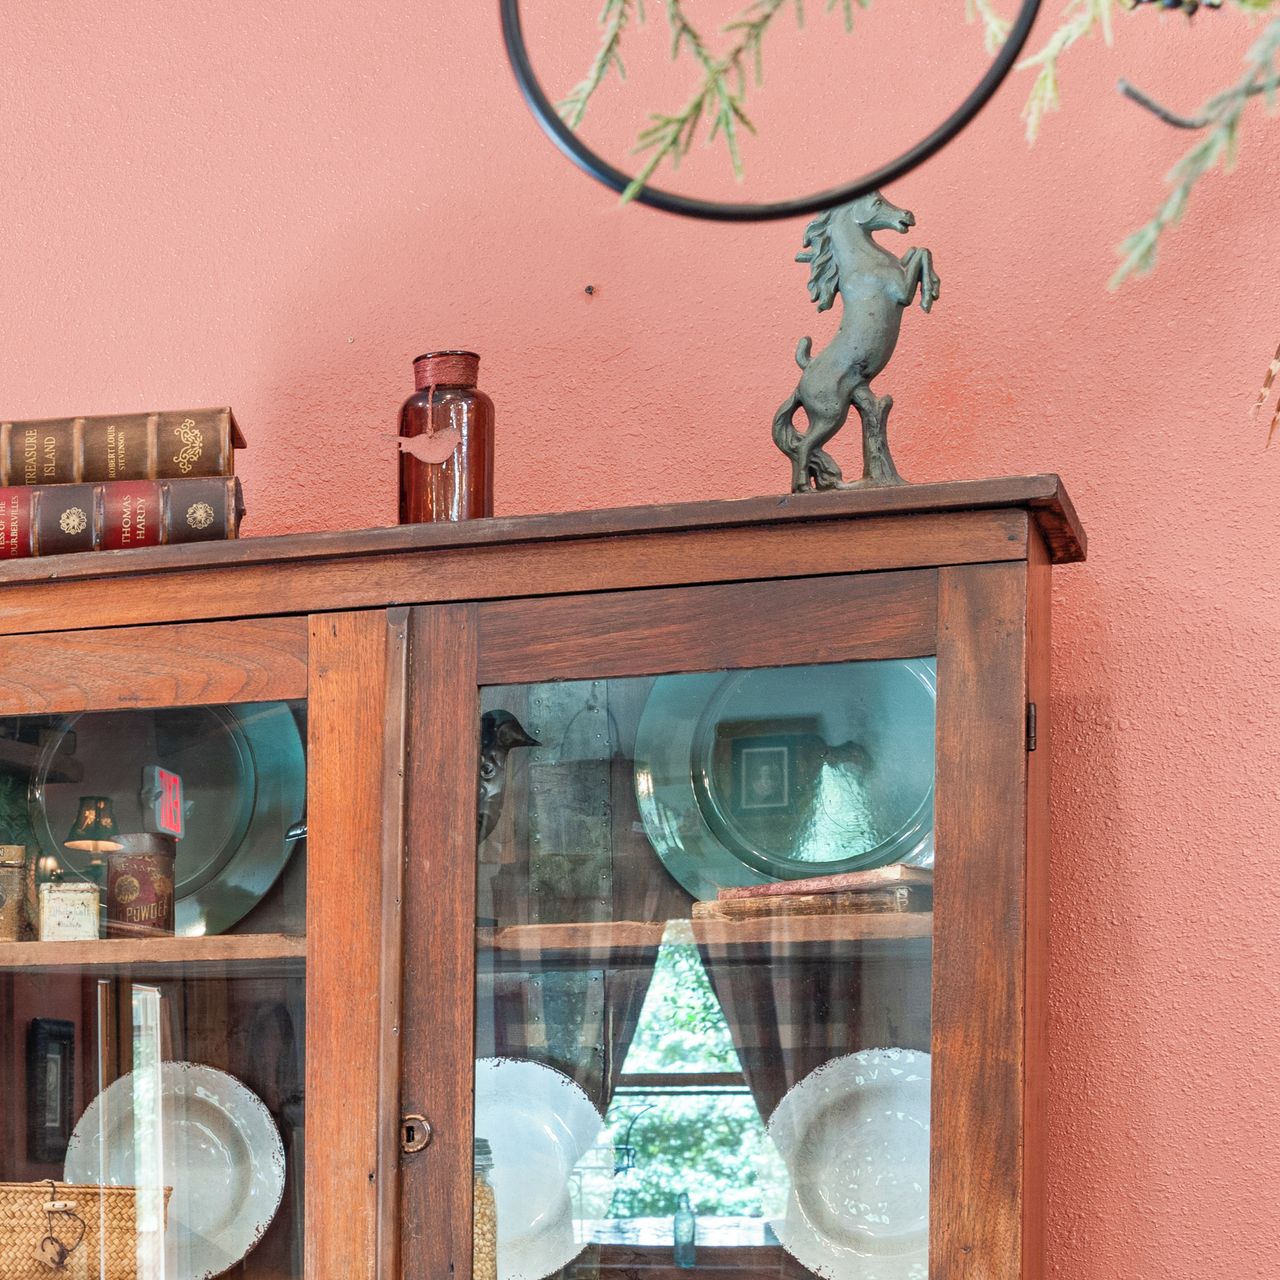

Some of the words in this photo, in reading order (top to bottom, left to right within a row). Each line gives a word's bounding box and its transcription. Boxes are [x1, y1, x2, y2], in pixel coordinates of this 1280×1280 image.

[25, 429, 37, 486] TREASURE
[44, 436, 56, 477] ISLAND
[108, 447, 116, 478] ROBERT
[118, 431, 126, 471] STEVENSON
[122, 495, 131, 545] THOMAS
[136, 496, 146, 540] HARDY
